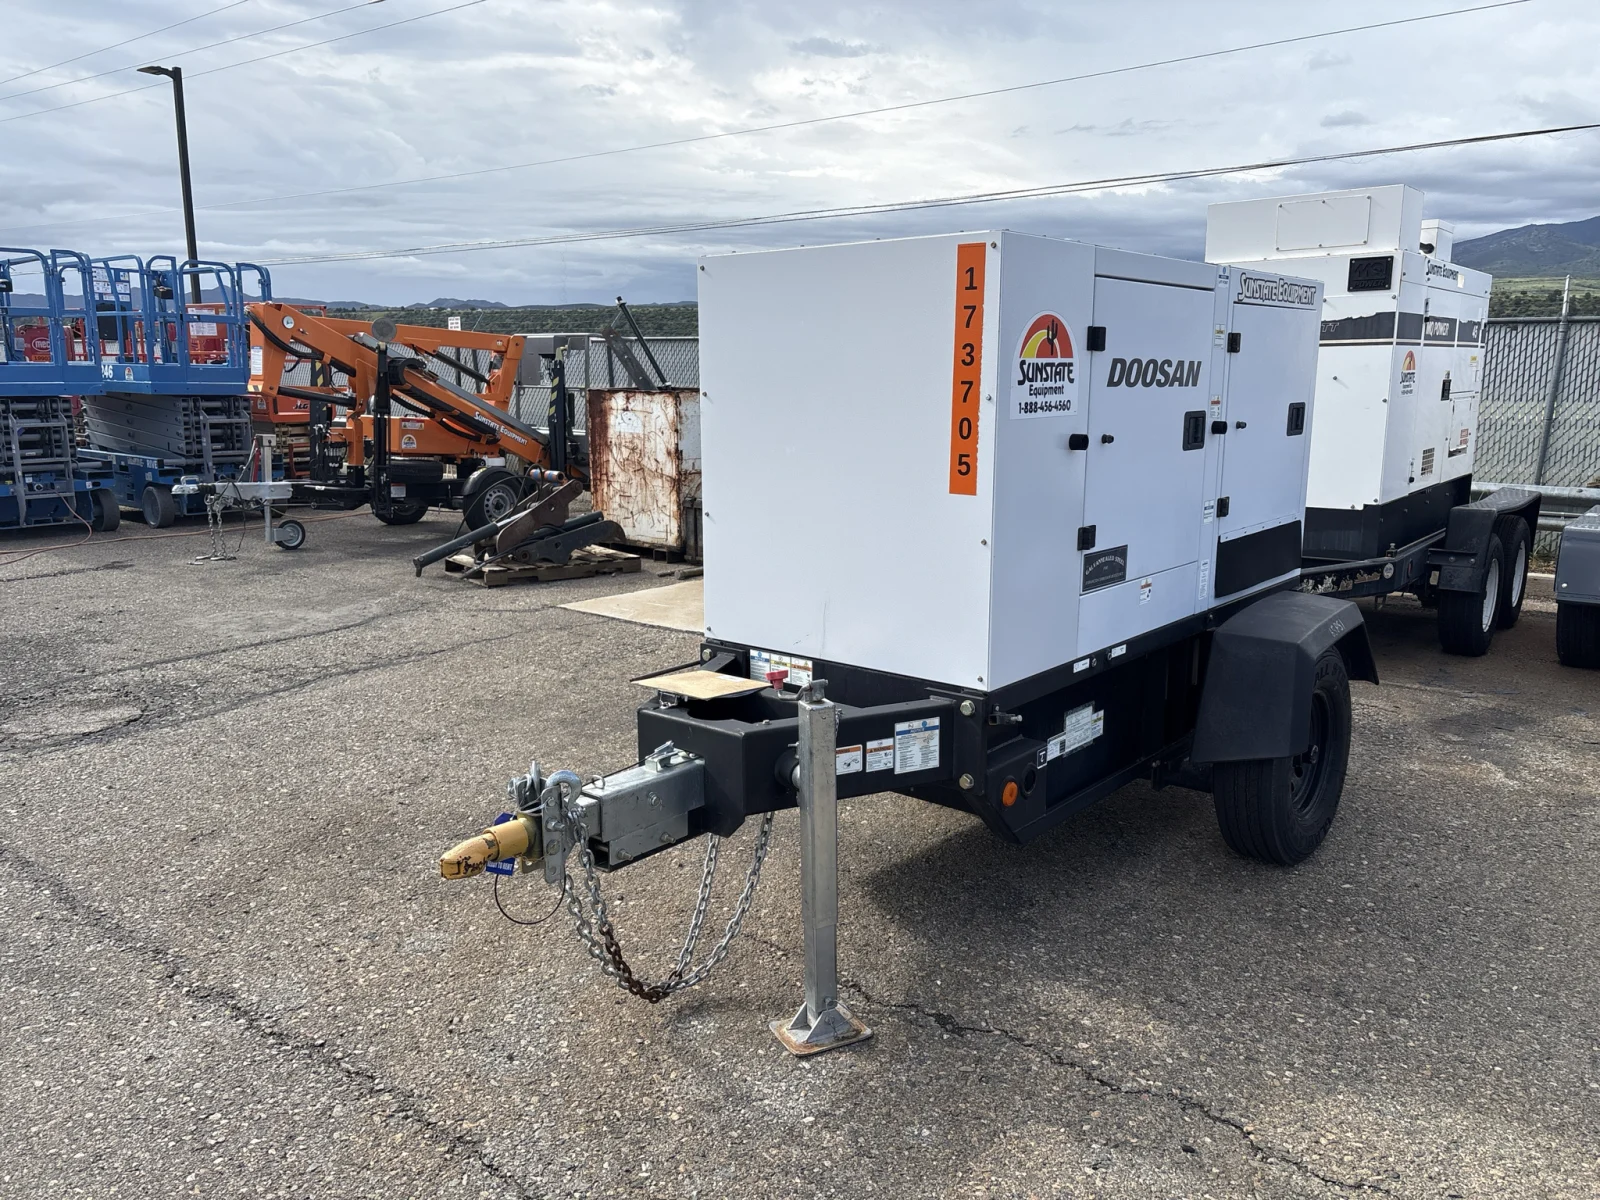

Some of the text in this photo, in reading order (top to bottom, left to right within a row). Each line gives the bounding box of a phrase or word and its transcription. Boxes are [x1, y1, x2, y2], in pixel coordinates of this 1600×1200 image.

[1354, 262, 1385, 278] MQ
[1354, 279, 1386, 288] POWER
[1106, 358, 1202, 388] DOOSAN
[1028, 383, 1065, 399] Equipment
[293, 402, 309, 410] JLG
[1018, 400, 1072, 415] 1-888-456-4560
